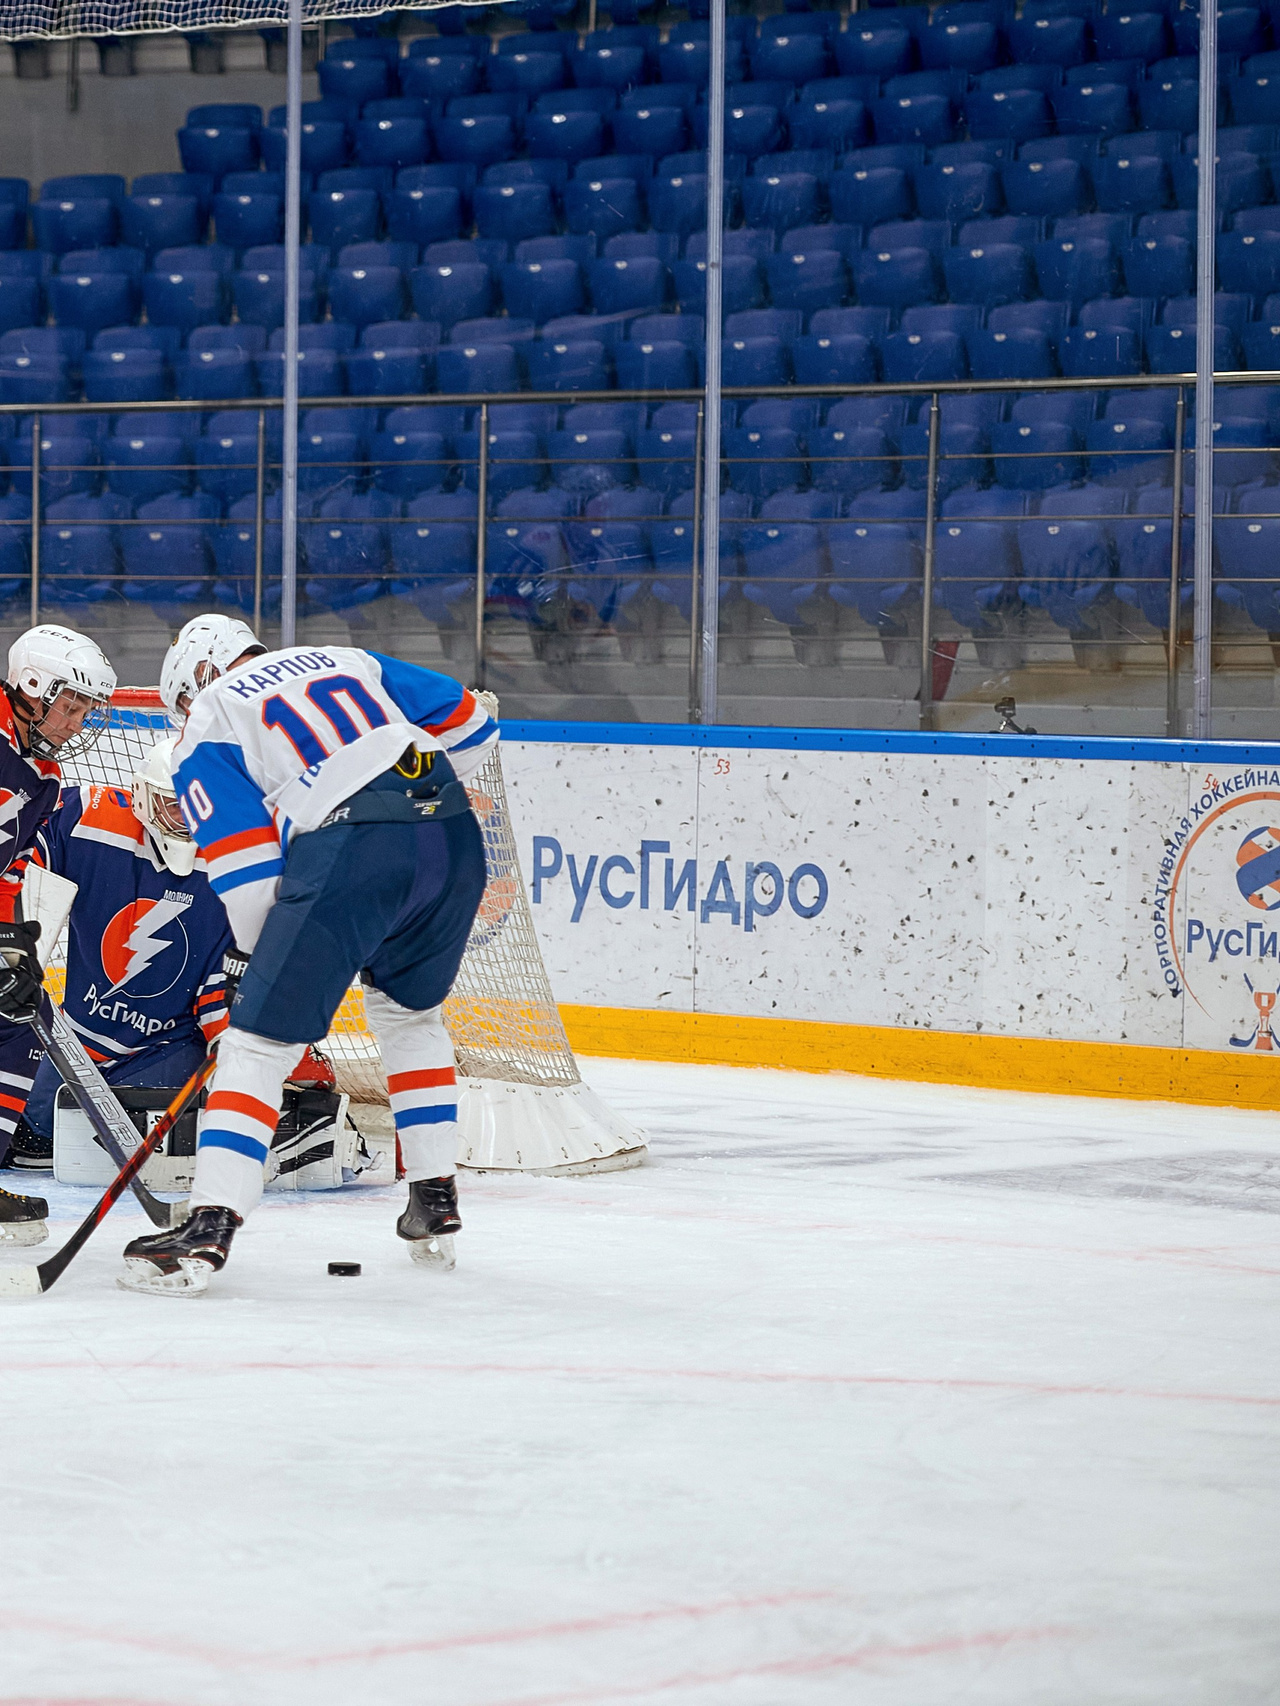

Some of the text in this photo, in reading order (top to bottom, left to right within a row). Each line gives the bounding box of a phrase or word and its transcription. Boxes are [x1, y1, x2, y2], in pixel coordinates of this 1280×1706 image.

[227, 651, 337, 699] КАРПОВ
[261, 673, 391, 769] 10
[713, 758, 731, 776] 53
[180, 778, 214, 835] 10
[531, 834, 829, 932] РусГидро
[1153, 816, 1193, 998] КОРПОРАТИВНАЯ
[1186, 918, 1280, 963] РусГи
[83, 983, 176, 1036] РусГидро
